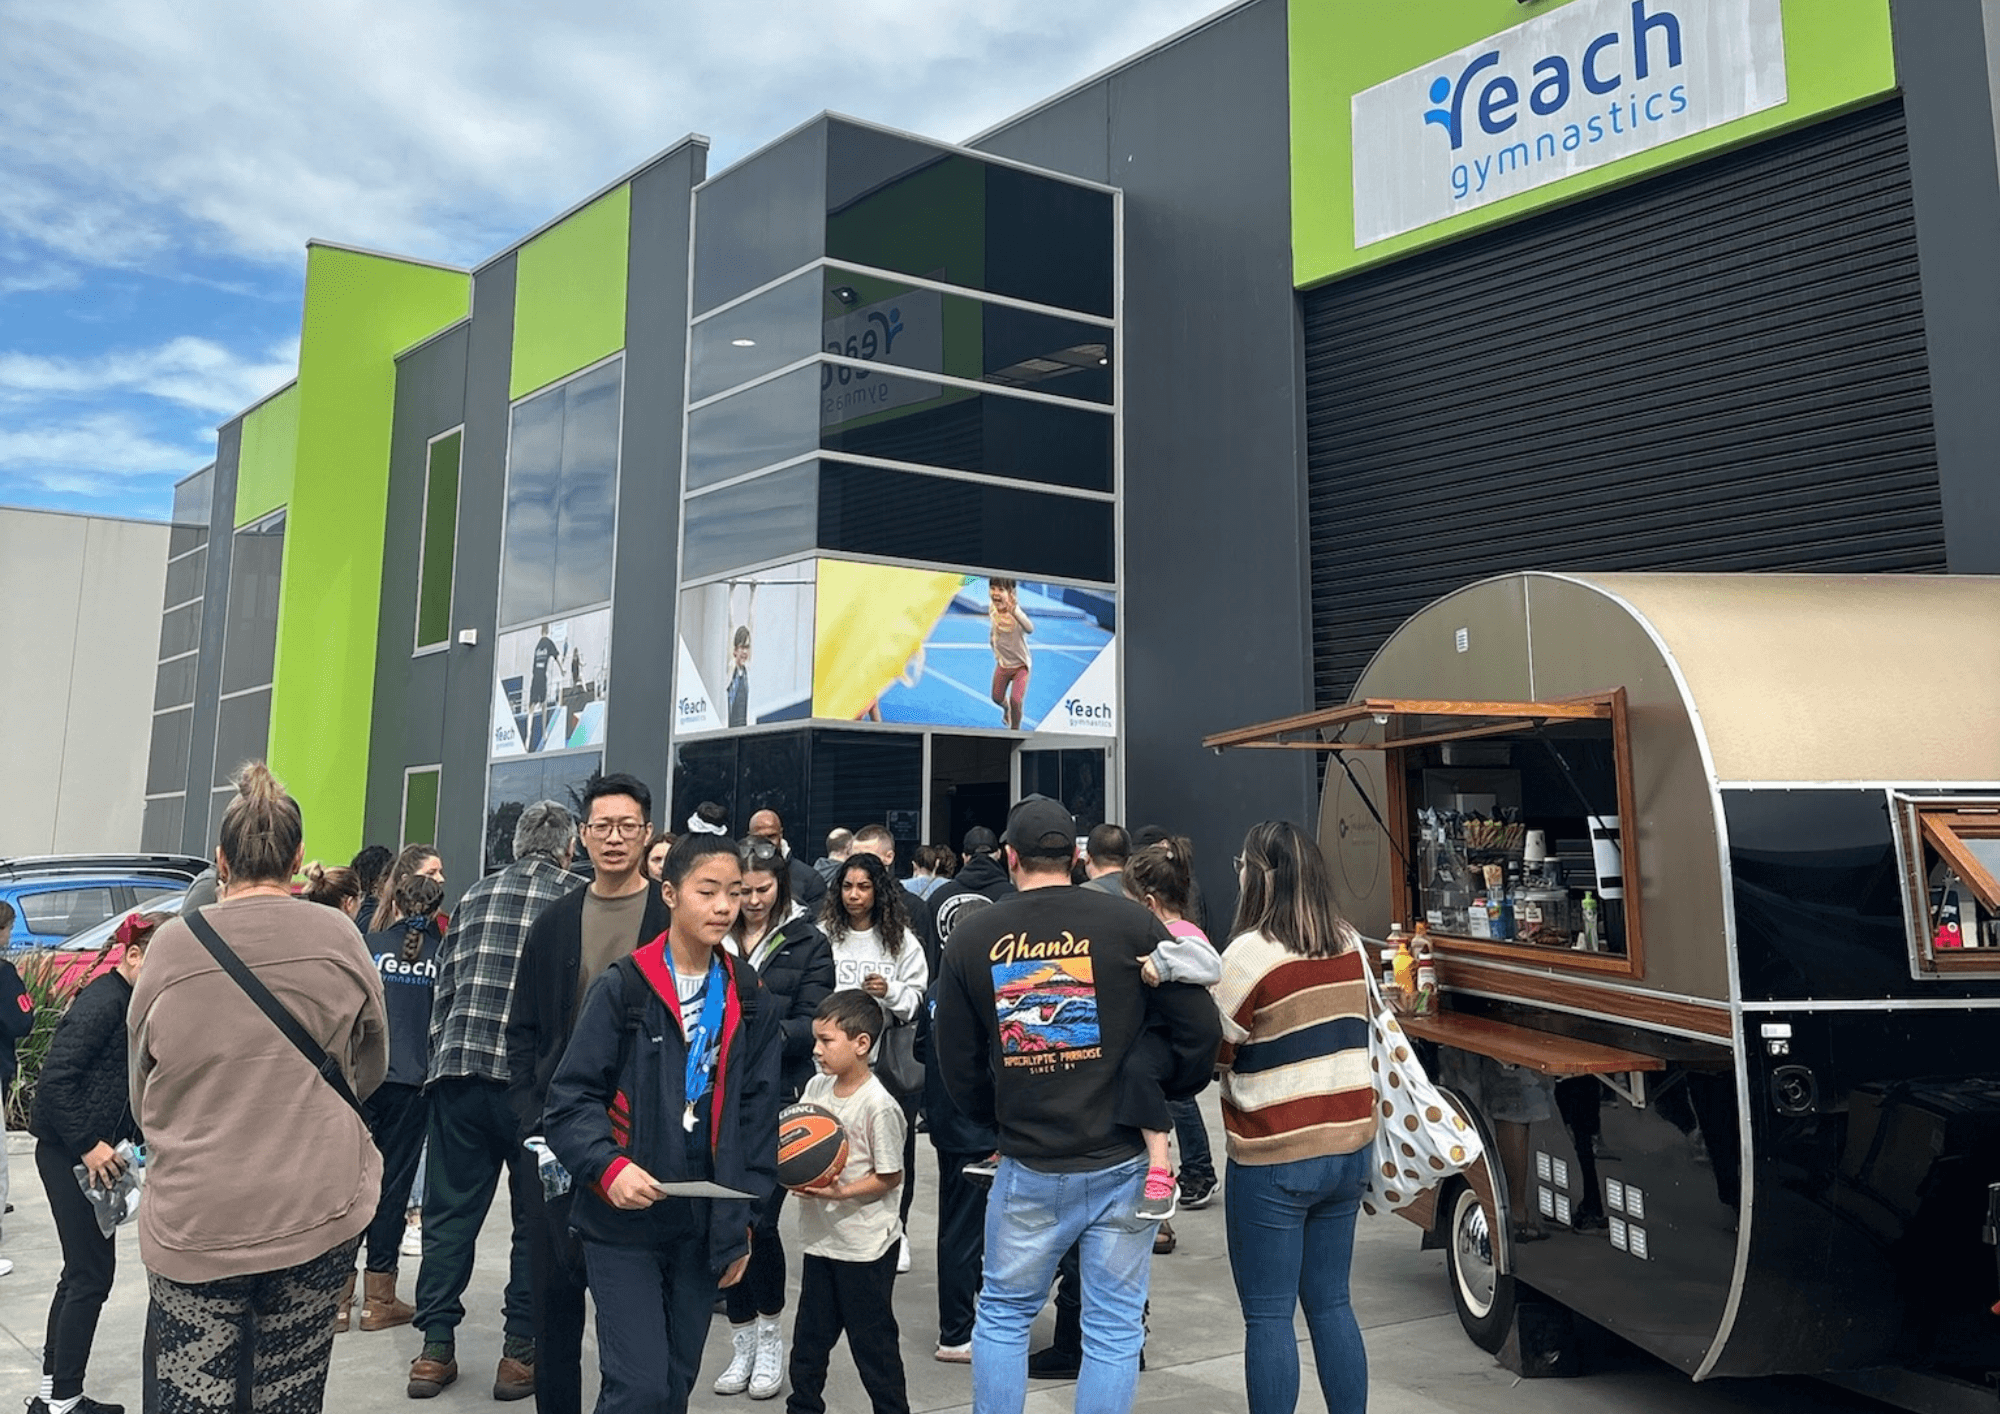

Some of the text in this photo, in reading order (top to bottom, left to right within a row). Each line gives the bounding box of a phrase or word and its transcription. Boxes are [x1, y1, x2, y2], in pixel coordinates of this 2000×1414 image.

[1424, 0, 1682, 151] reach
[1451, 83, 1688, 200] gymnastics
[679, 697, 706, 715] reach
[1065, 699, 1111, 719] reach
[989, 931, 1090, 967] Ghanda
[374, 952, 436, 979] reach
